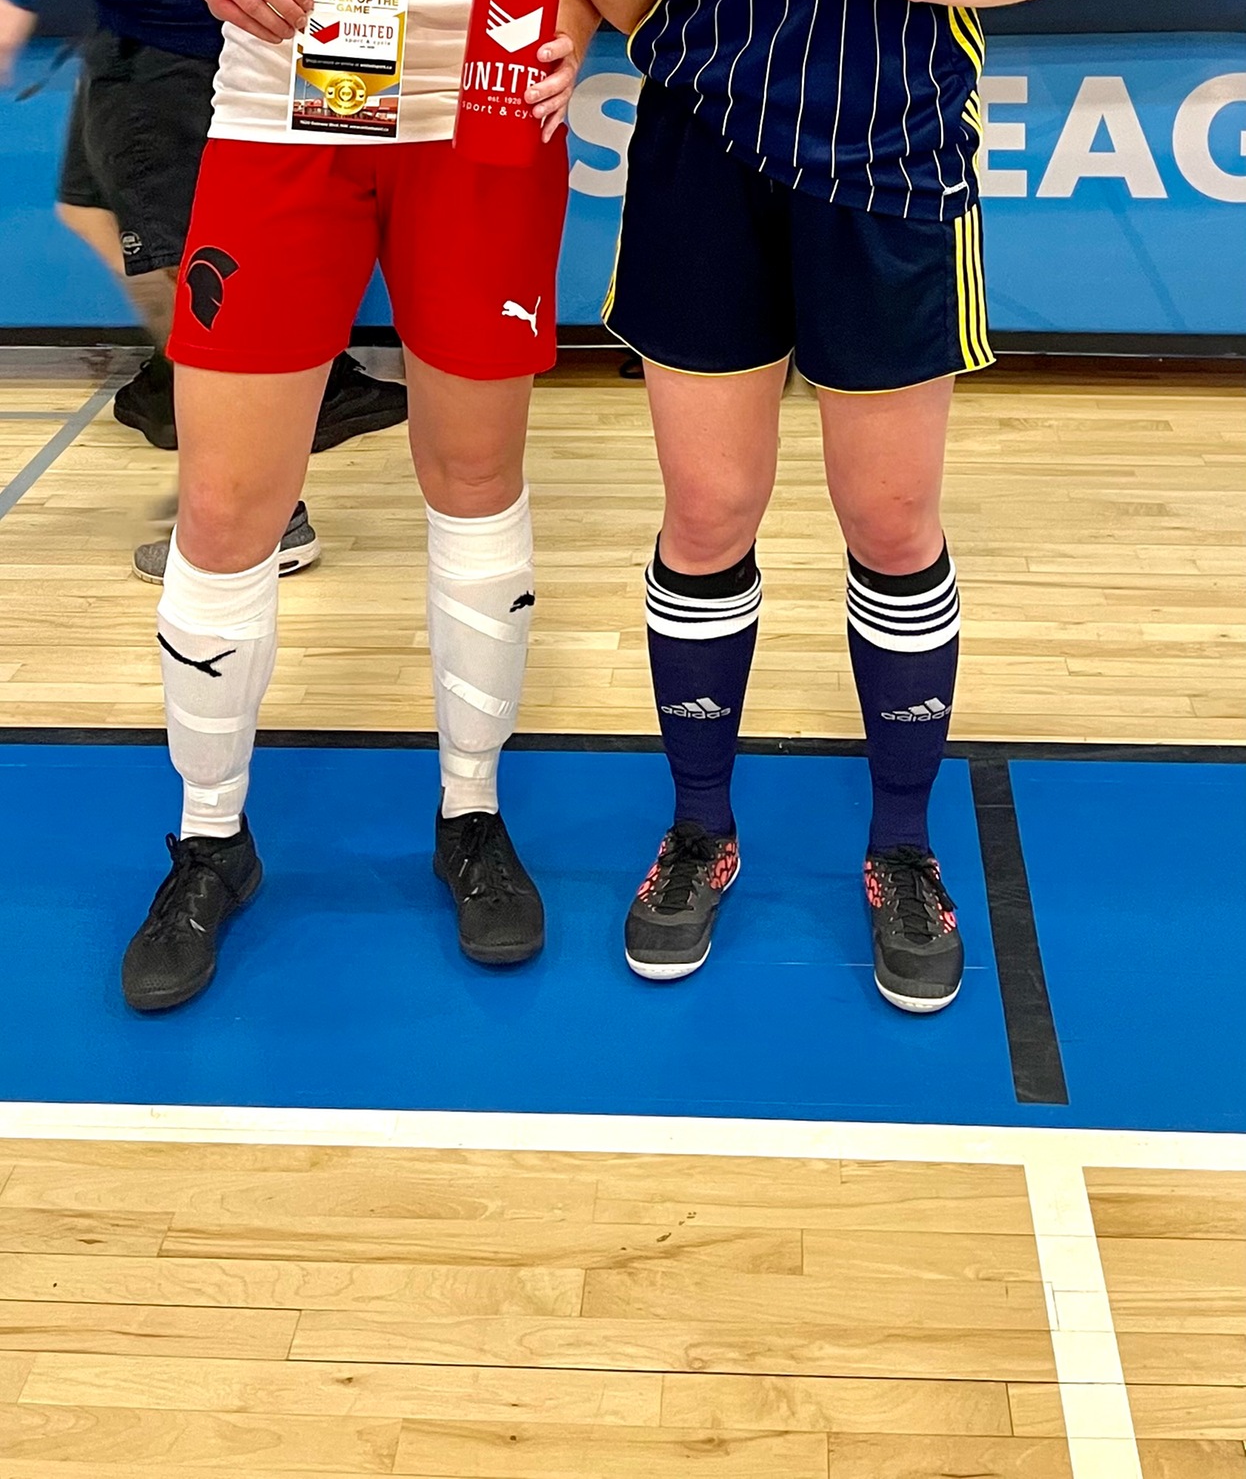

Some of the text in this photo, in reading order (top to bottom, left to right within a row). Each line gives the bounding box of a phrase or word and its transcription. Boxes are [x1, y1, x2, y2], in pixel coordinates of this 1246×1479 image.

[336, 3, 370, 14] GAME
[462, 100, 492, 114] sport
[499, 106, 507, 116] &
[660, 706, 731, 720] adidas
